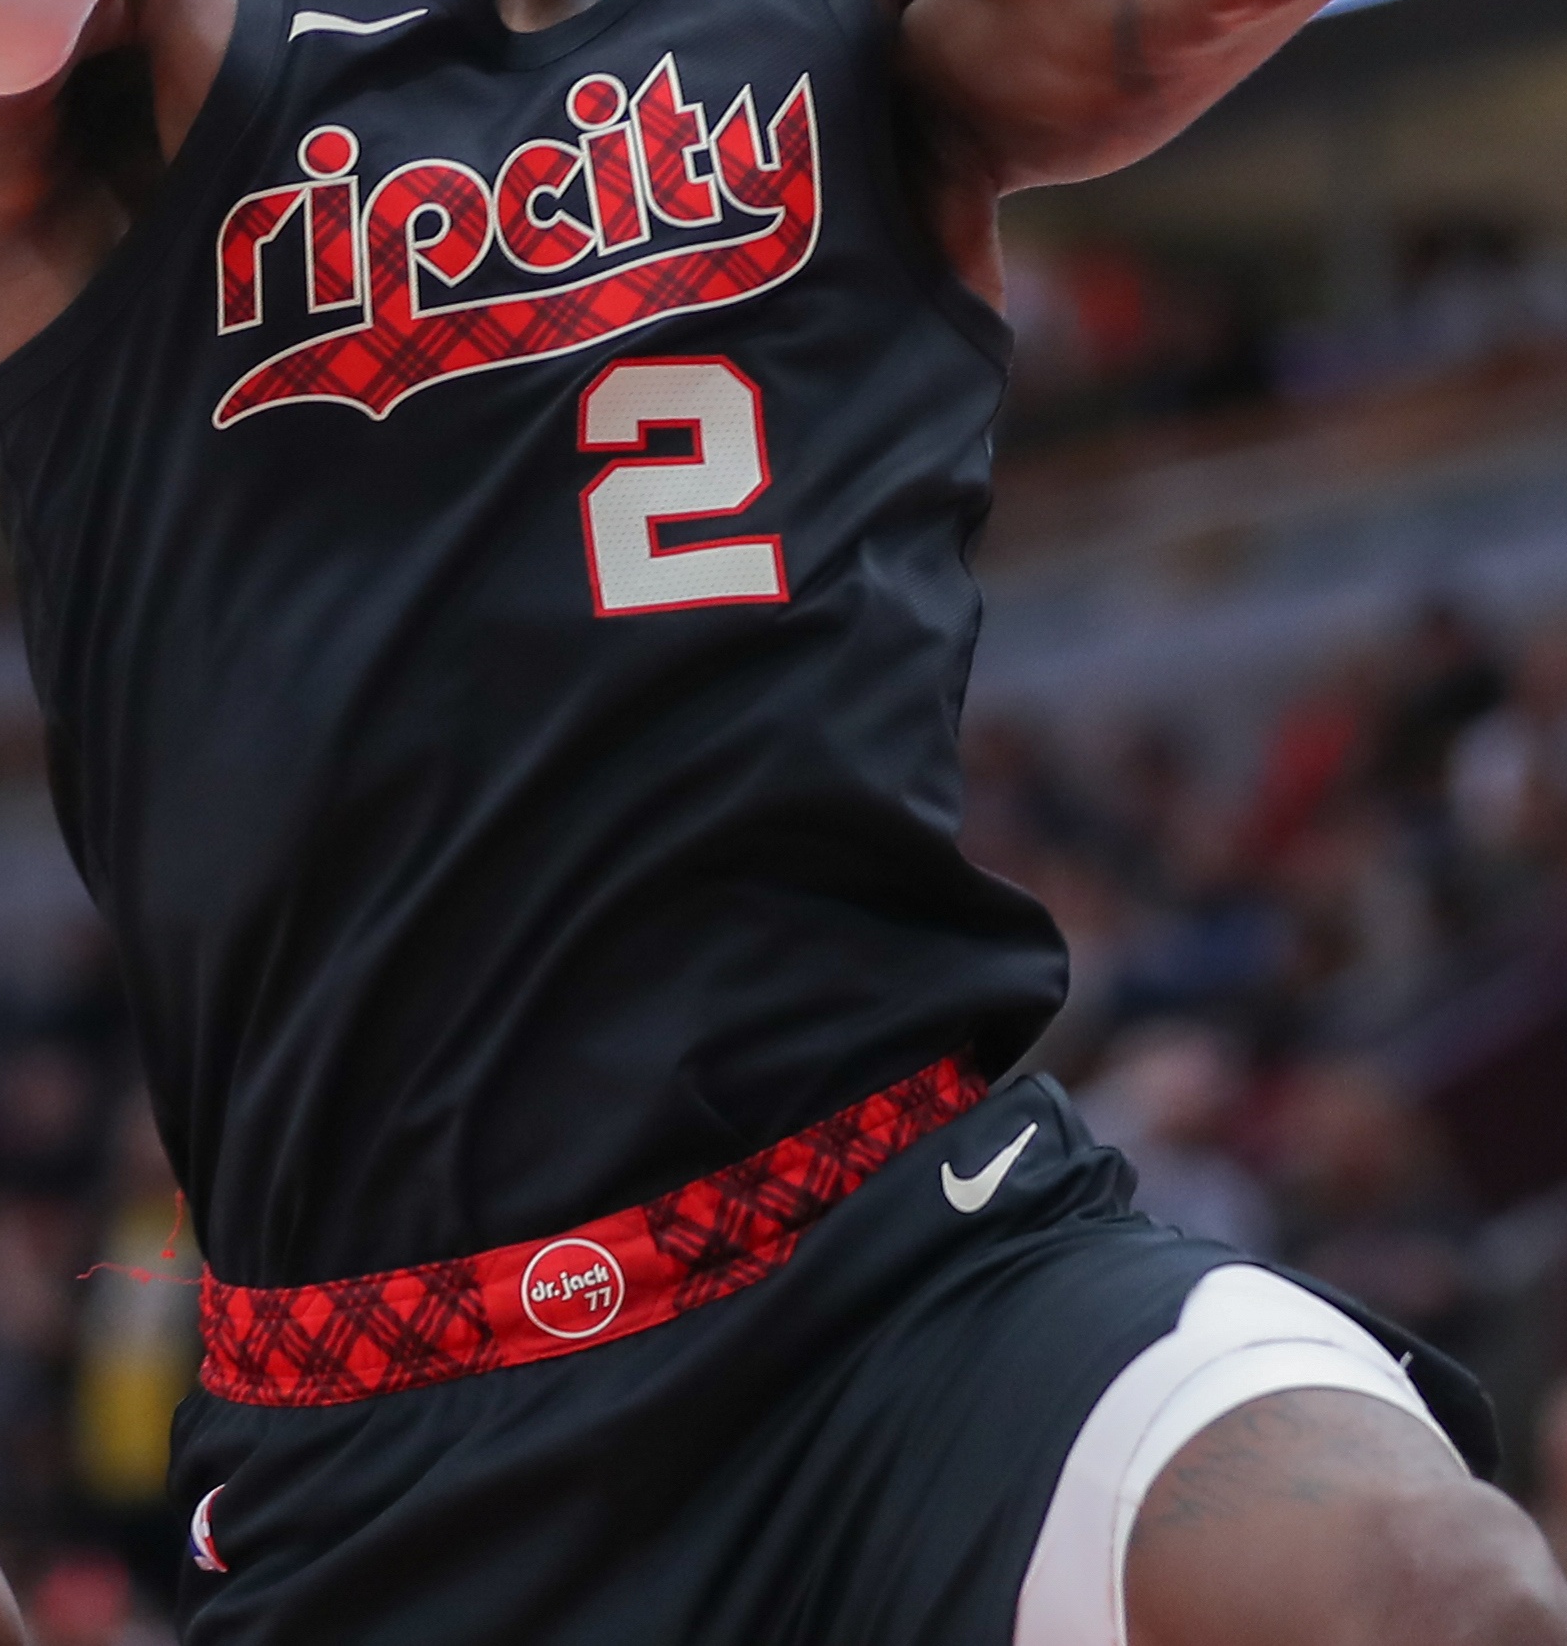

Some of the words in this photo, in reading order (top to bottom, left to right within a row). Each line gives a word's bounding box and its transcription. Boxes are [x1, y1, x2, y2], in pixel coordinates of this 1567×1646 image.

[212, 51, 824, 430] ripcity
[577, 355, 790, 618] 2
[531, 1280, 561, 1302] dr.
[560, 1263, 610, 1301] jack
[584, 1286, 612, 1312] 77
